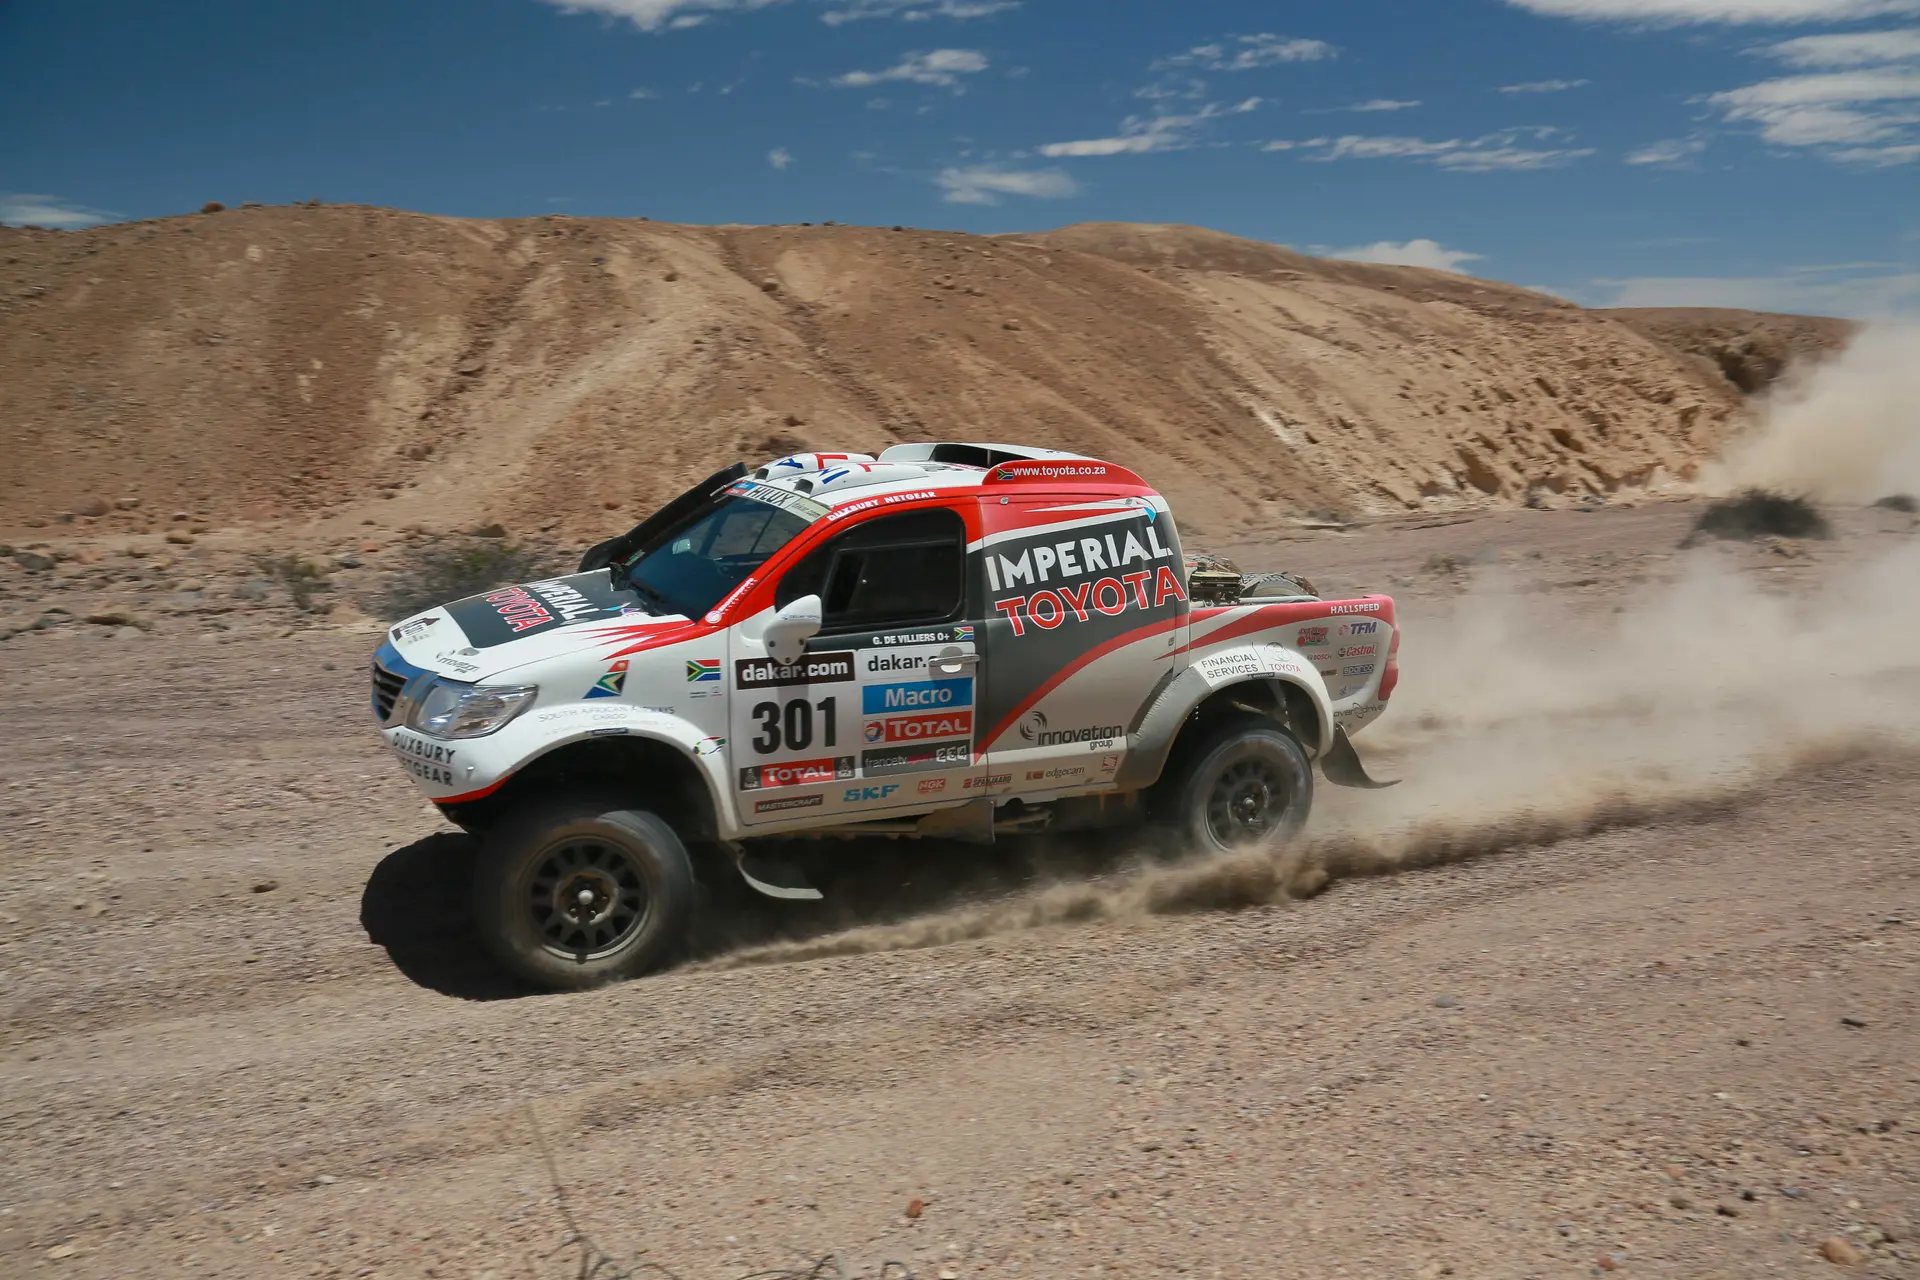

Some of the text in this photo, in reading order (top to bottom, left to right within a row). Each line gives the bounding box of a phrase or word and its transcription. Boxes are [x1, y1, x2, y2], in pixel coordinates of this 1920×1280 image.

[1013, 465, 1106, 478] www.toyota.co.za
[746, 486, 794, 506] HILUX
[826, 490, 937, 522] DUXBURY NETGEAR
[984, 525, 1174, 592] IMPERIAL
[995, 565, 1188, 637] TOYOTA
[1330, 603, 1380, 614] HALLSPEED
[1350, 622, 1377, 635] TFM
[872, 636, 883, 645] G.
[884, 635, 896, 644] DE
[896, 632, 936, 643] VILLIERS
[1346, 644, 1376, 657] Castrol
[1201, 653, 1258, 668] FINANCIAL
[1268, 663, 1302, 673] TOYOTA
[741, 661, 849, 682] dakar.com
[1206, 664, 1259, 679] SERVICES
[1343, 664, 1374, 674] sparco
[884, 687, 953, 708] Macro
[752, 696, 837, 755] 301
[888, 718, 969, 738] TOTAL
[1037, 725, 1123, 746] innovation
[392, 732, 456, 764] DUXBURY
[1089, 739, 1113, 751] group
[763, 765, 833, 782] TOTAL
[1045, 766, 1086, 779] edgecam
[842, 784, 900, 802] SKF
[918, 780, 945, 791] NGK
[757, 797, 822, 811] MASTERCRAFT
